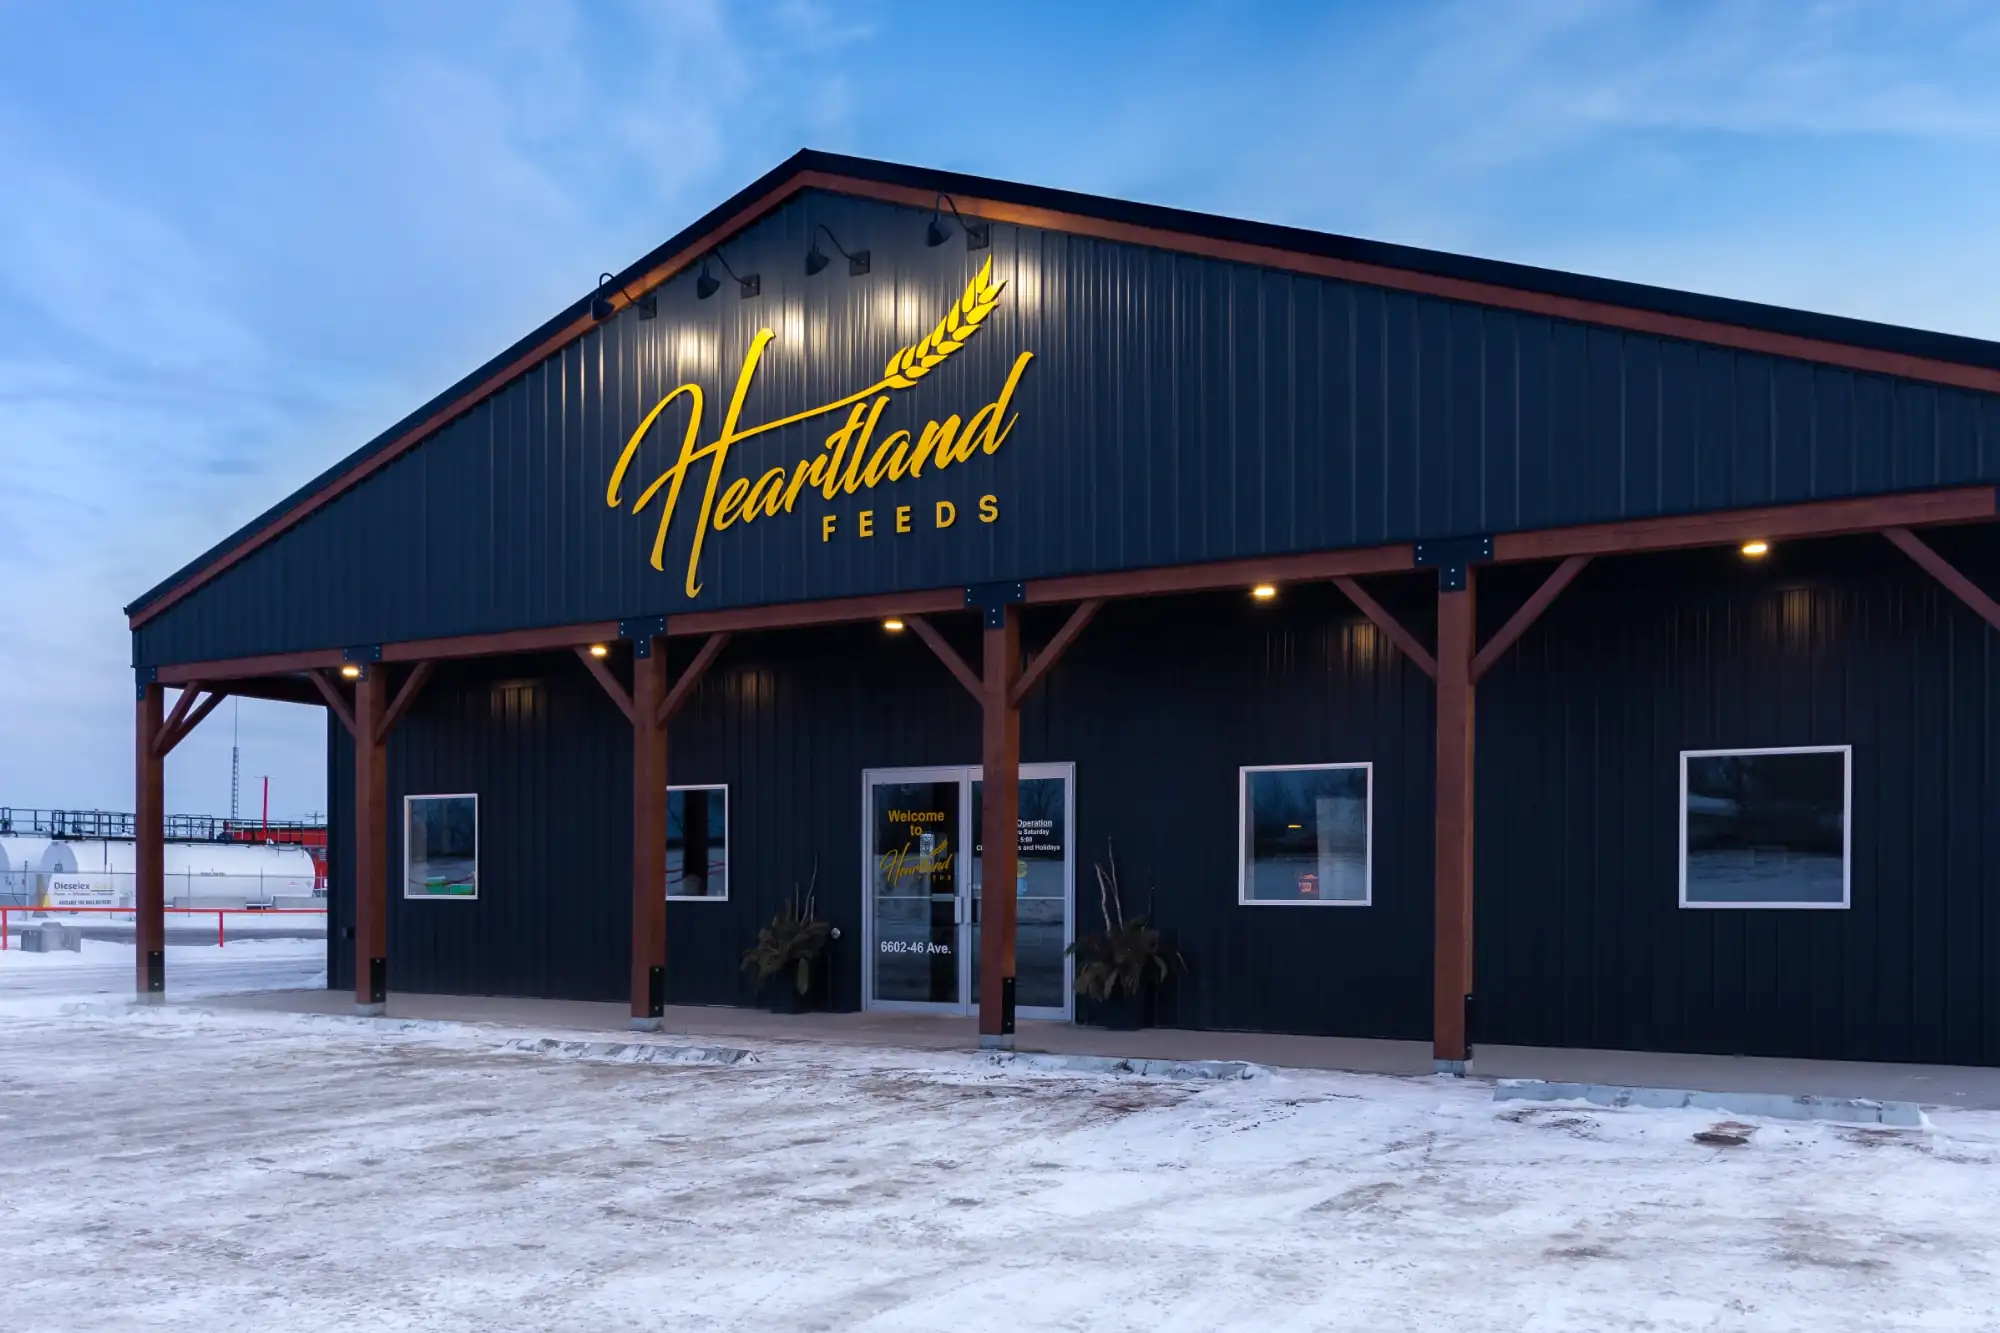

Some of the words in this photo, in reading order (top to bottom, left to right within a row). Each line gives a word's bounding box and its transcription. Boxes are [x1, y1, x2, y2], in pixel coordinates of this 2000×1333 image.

[607, 328, 1035, 598] Heartland
[822, 494, 1000, 543] FEEDS
[888, 810, 945, 822] Welcome
[1017, 819, 1053, 828] Operation
[910, 824, 923, 836] to
[54, 881, 91, 890] Dieselex
[880, 941, 925, 953] 6602-46
[926, 942, 952, 954] Ave.
